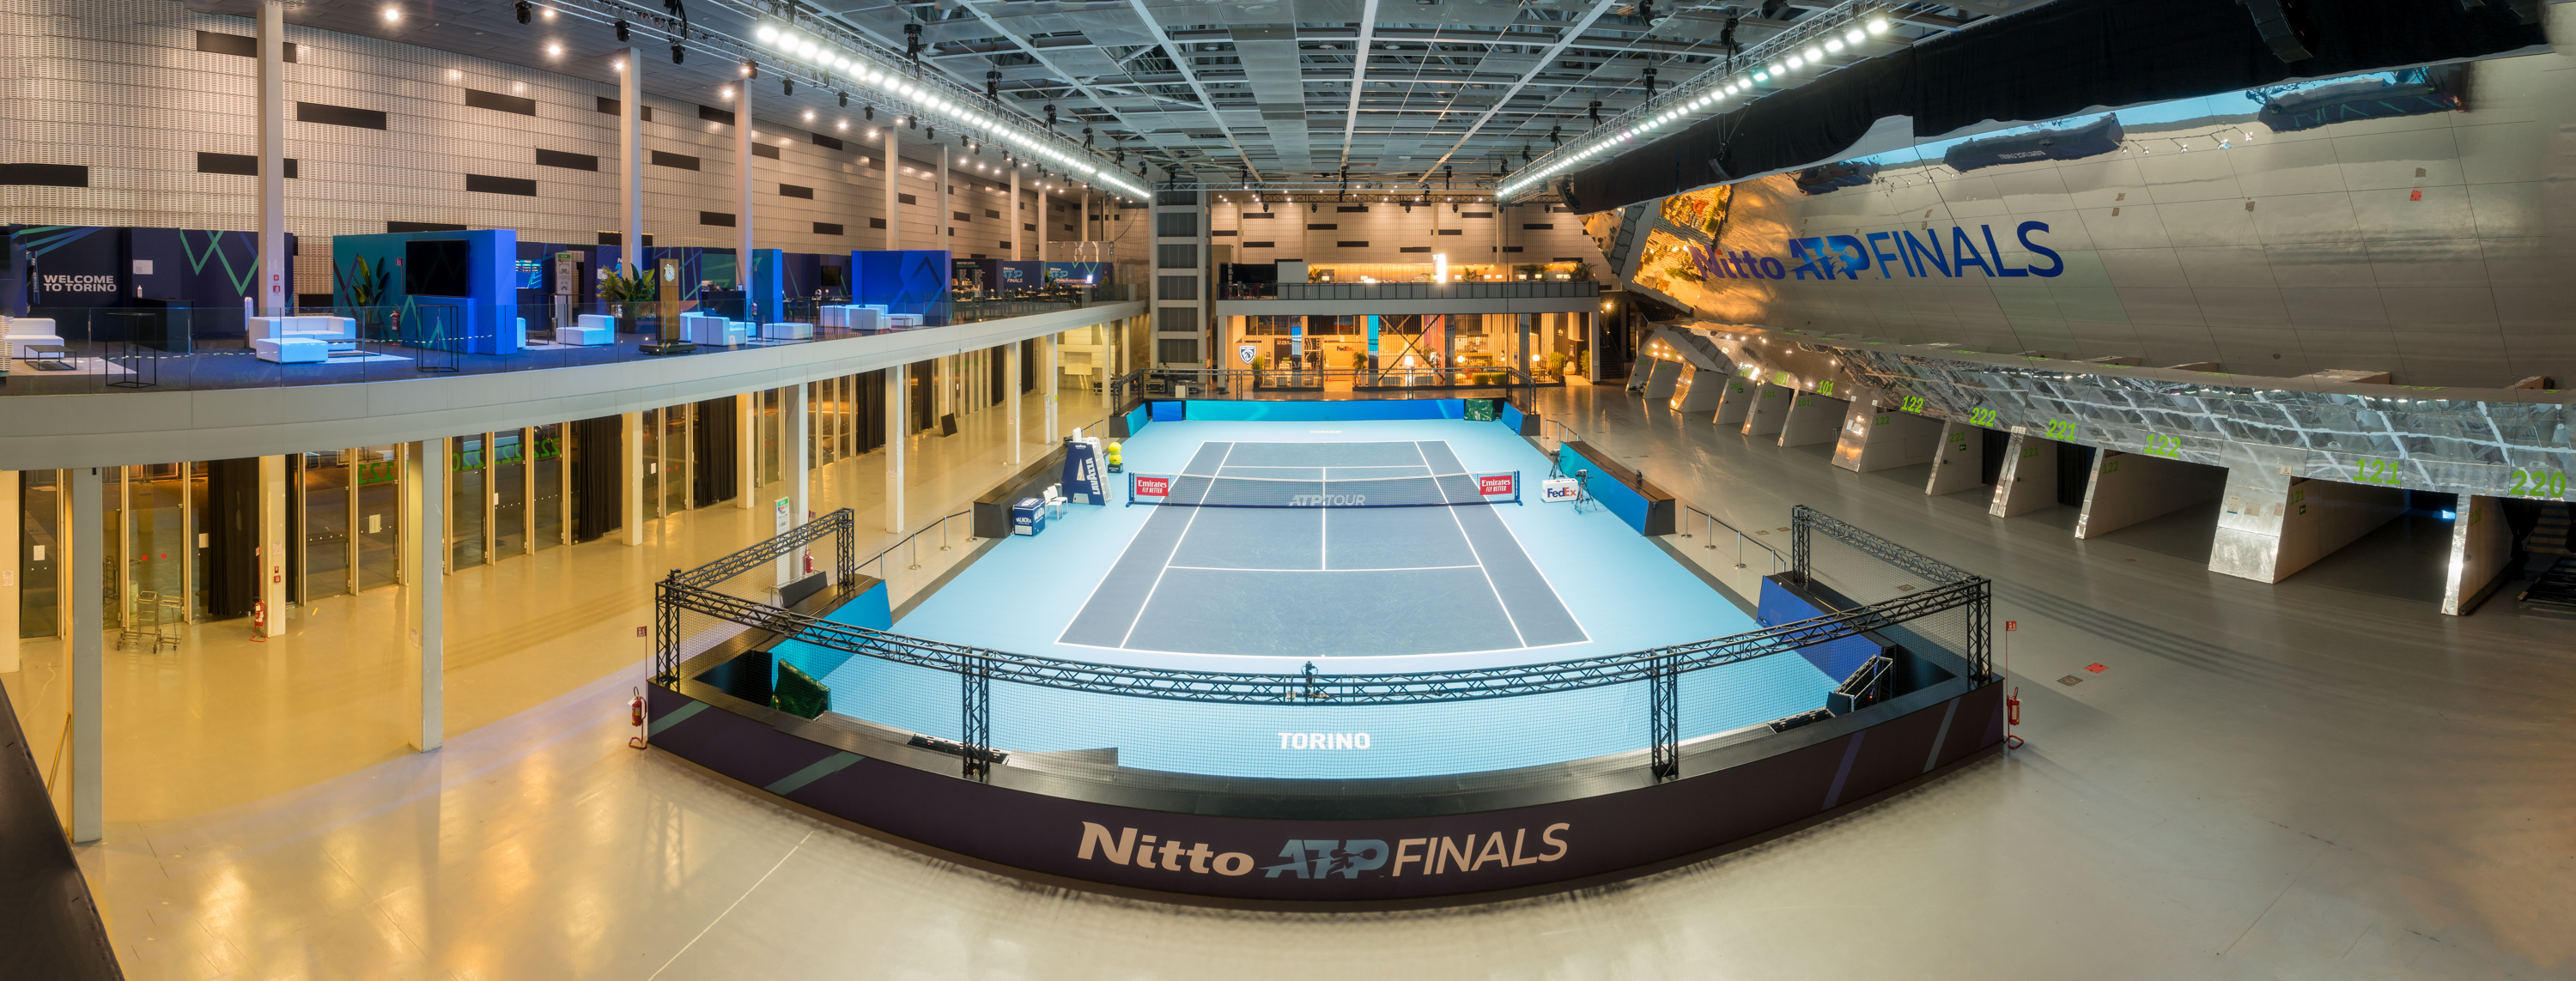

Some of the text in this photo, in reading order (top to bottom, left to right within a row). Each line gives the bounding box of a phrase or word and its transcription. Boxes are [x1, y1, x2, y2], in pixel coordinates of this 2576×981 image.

[1688, 221, 2064, 280] Nitto ATP FINALS
[44, 275, 114, 284] WELCOME
[44, 283, 117, 292] TO TORINO
[1774, 372, 1789, 385] 201
[1817, 379, 1834, 396] 101
[1797, 398, 1810, 407] 101
[1900, 395, 1923, 414] 122
[1874, 416, 1890, 426] 122
[1969, 408, 1996, 427] 222
[1949, 432, 1965, 443] 222
[2045, 420, 2076, 441] 221
[2023, 446, 2039, 458] 221
[2143, 433, 2181, 457] 122
[1085, 457, 1101, 495] LAVAZZA
[2102, 460, 2119, 474] 122
[2353, 457, 2401, 485] 121
[1547, 487, 1577, 498] FedEx
[2510, 469, 2567, 498] 220
[1288, 494, 1366, 506] ATP TOUR
[2289, 488, 2306, 506] 121
[2470, 507, 2482, 526] 220
[1278, 732, 1371, 750] TORINO
[1077, 821, 1571, 880] Nitto ATP FINALS
